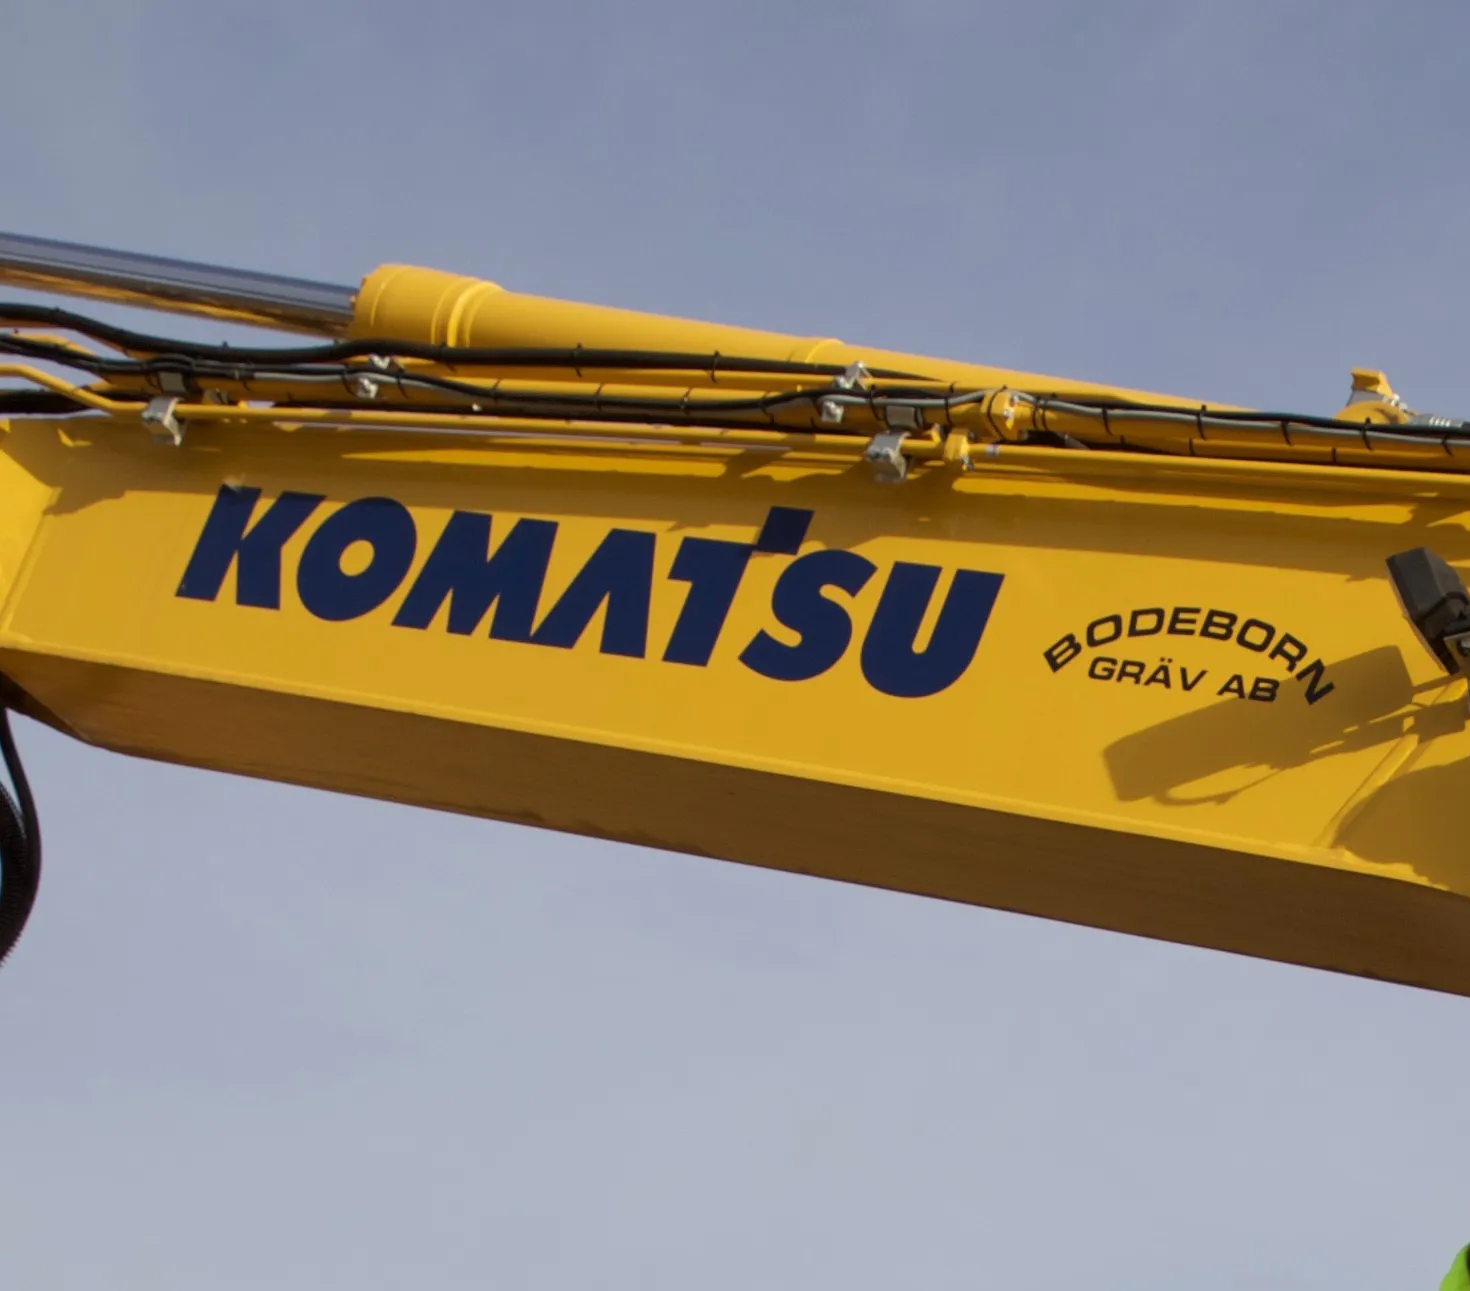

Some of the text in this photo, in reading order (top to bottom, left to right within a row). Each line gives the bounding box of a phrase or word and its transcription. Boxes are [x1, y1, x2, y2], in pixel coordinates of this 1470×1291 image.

[176, 483, 1005, 698] KOMATSU
[1043, 606, 1335, 705] BODEBORN
[1088, 656, 1280, 702] GRÄV AB
